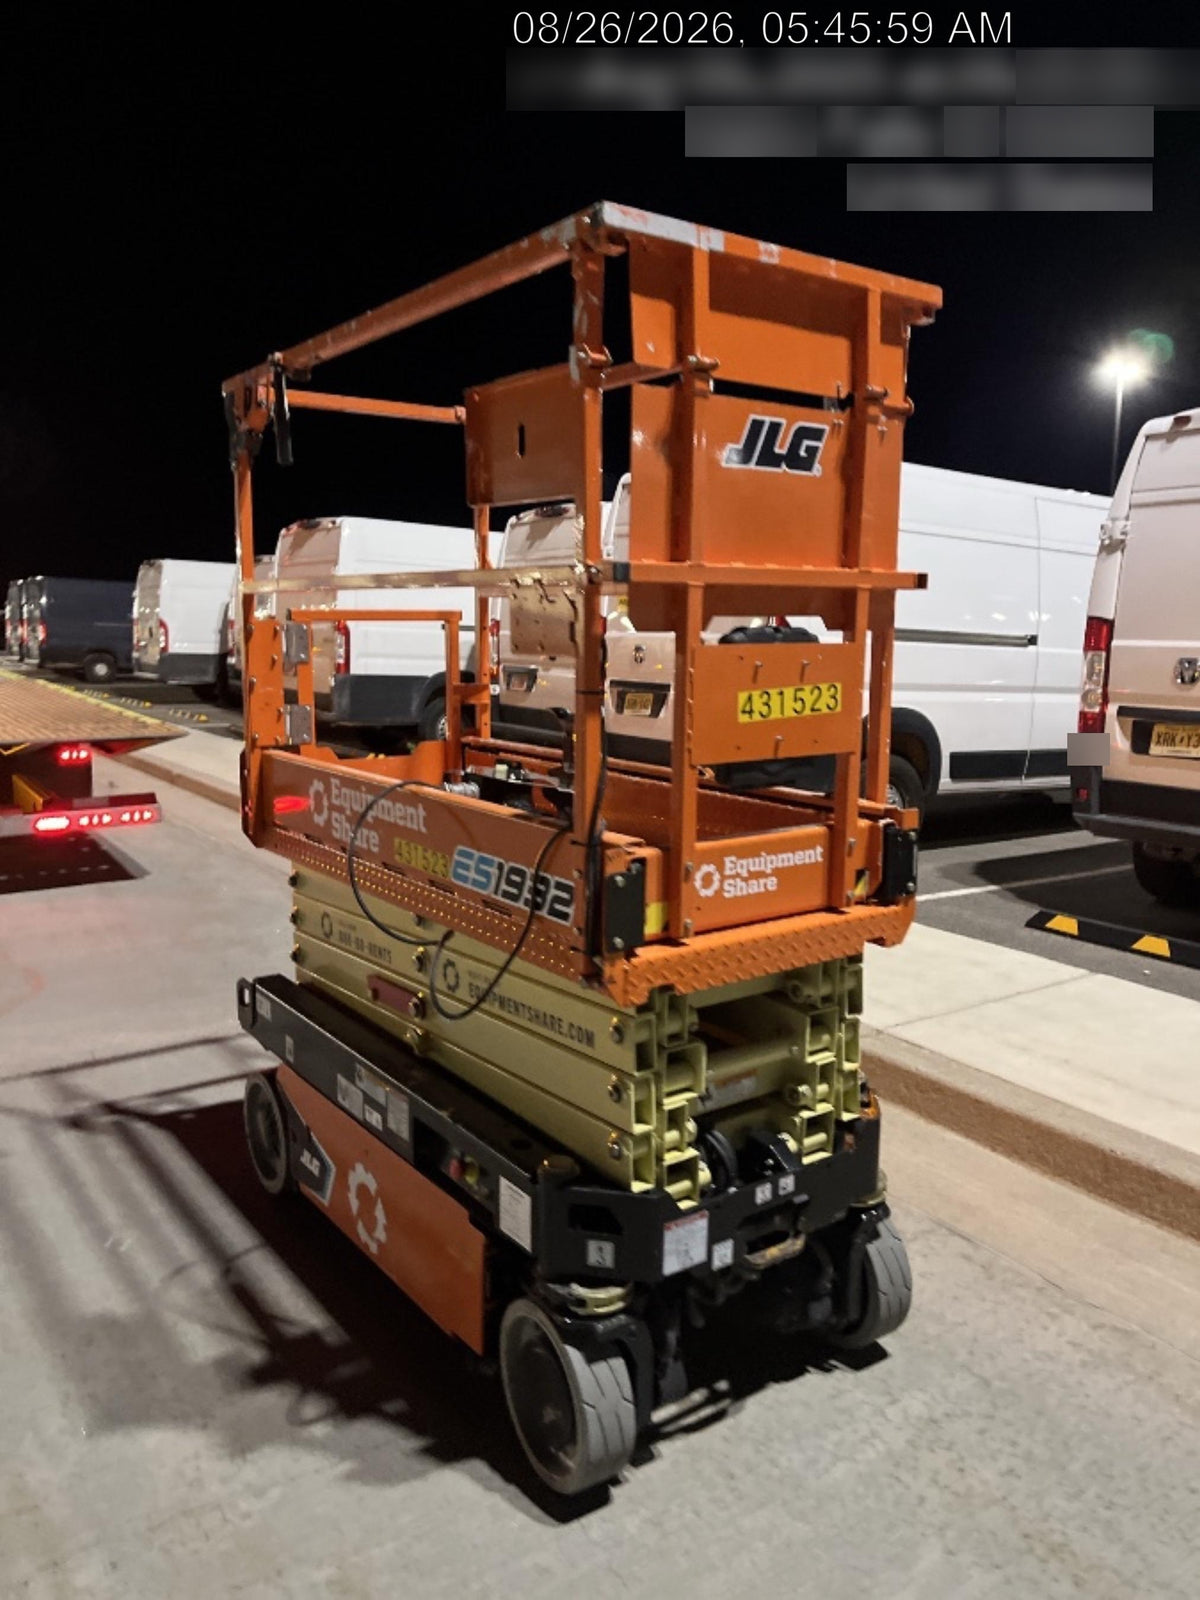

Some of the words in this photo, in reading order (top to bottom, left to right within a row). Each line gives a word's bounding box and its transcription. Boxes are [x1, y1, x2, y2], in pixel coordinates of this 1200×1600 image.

[721, 413, 829, 477] JLG
[740, 683, 839, 720] 431523
[331, 778, 427, 833] Equipment
[451, 844, 576, 926] ES1932
[723, 845, 824, 877] Equipment
[723, 876, 778, 898] Share
[468, 982, 595, 1049] EQPMENTSHARE.COM
